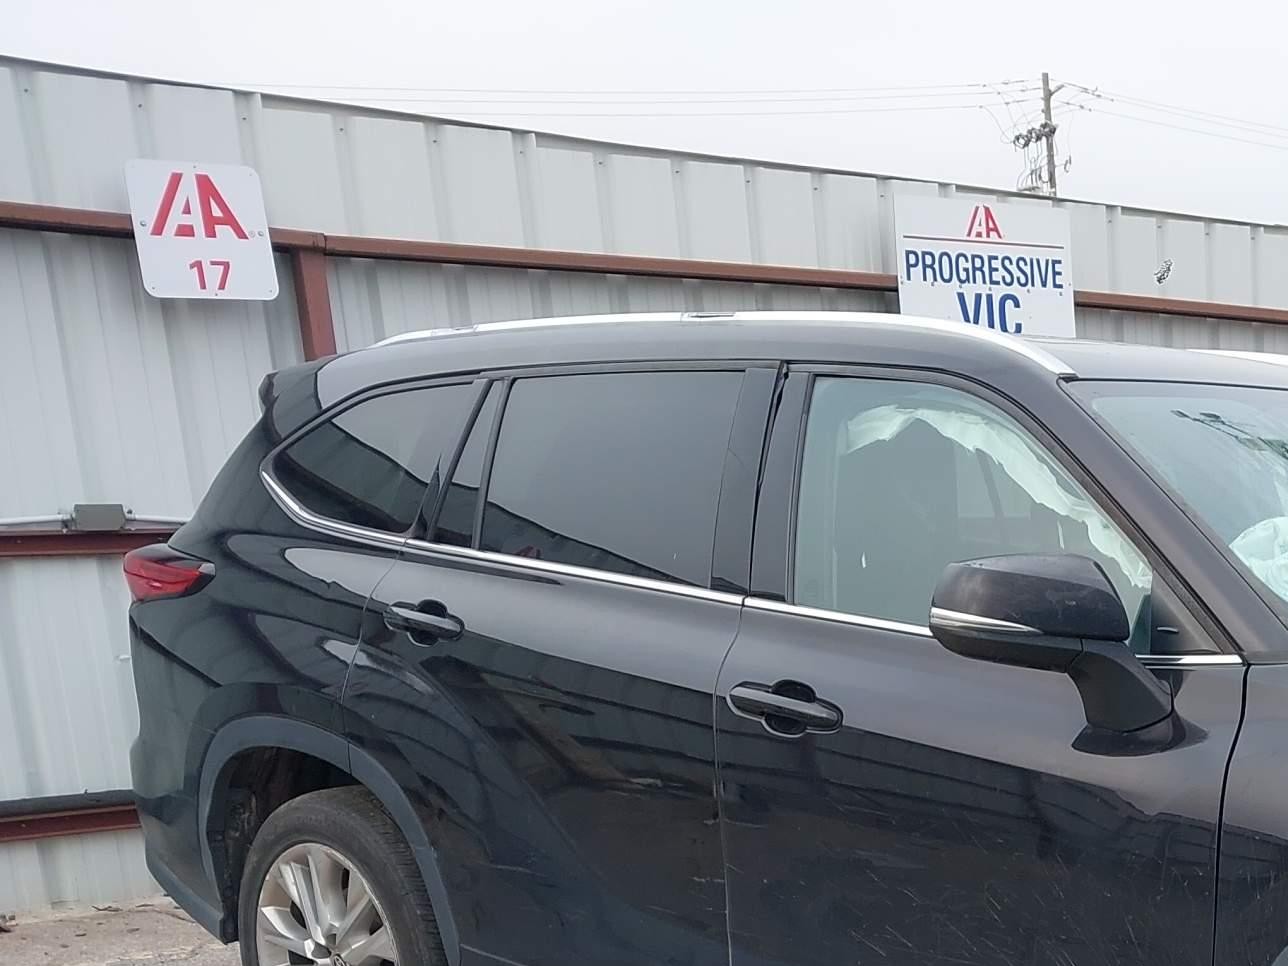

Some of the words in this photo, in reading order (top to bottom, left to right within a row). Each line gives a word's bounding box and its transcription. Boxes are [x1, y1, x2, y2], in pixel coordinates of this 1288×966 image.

[189, 259, 231, 291] 17
[904, 249, 1064, 290] PROGRESSIVE
[956, 291, 1023, 334] VIC
